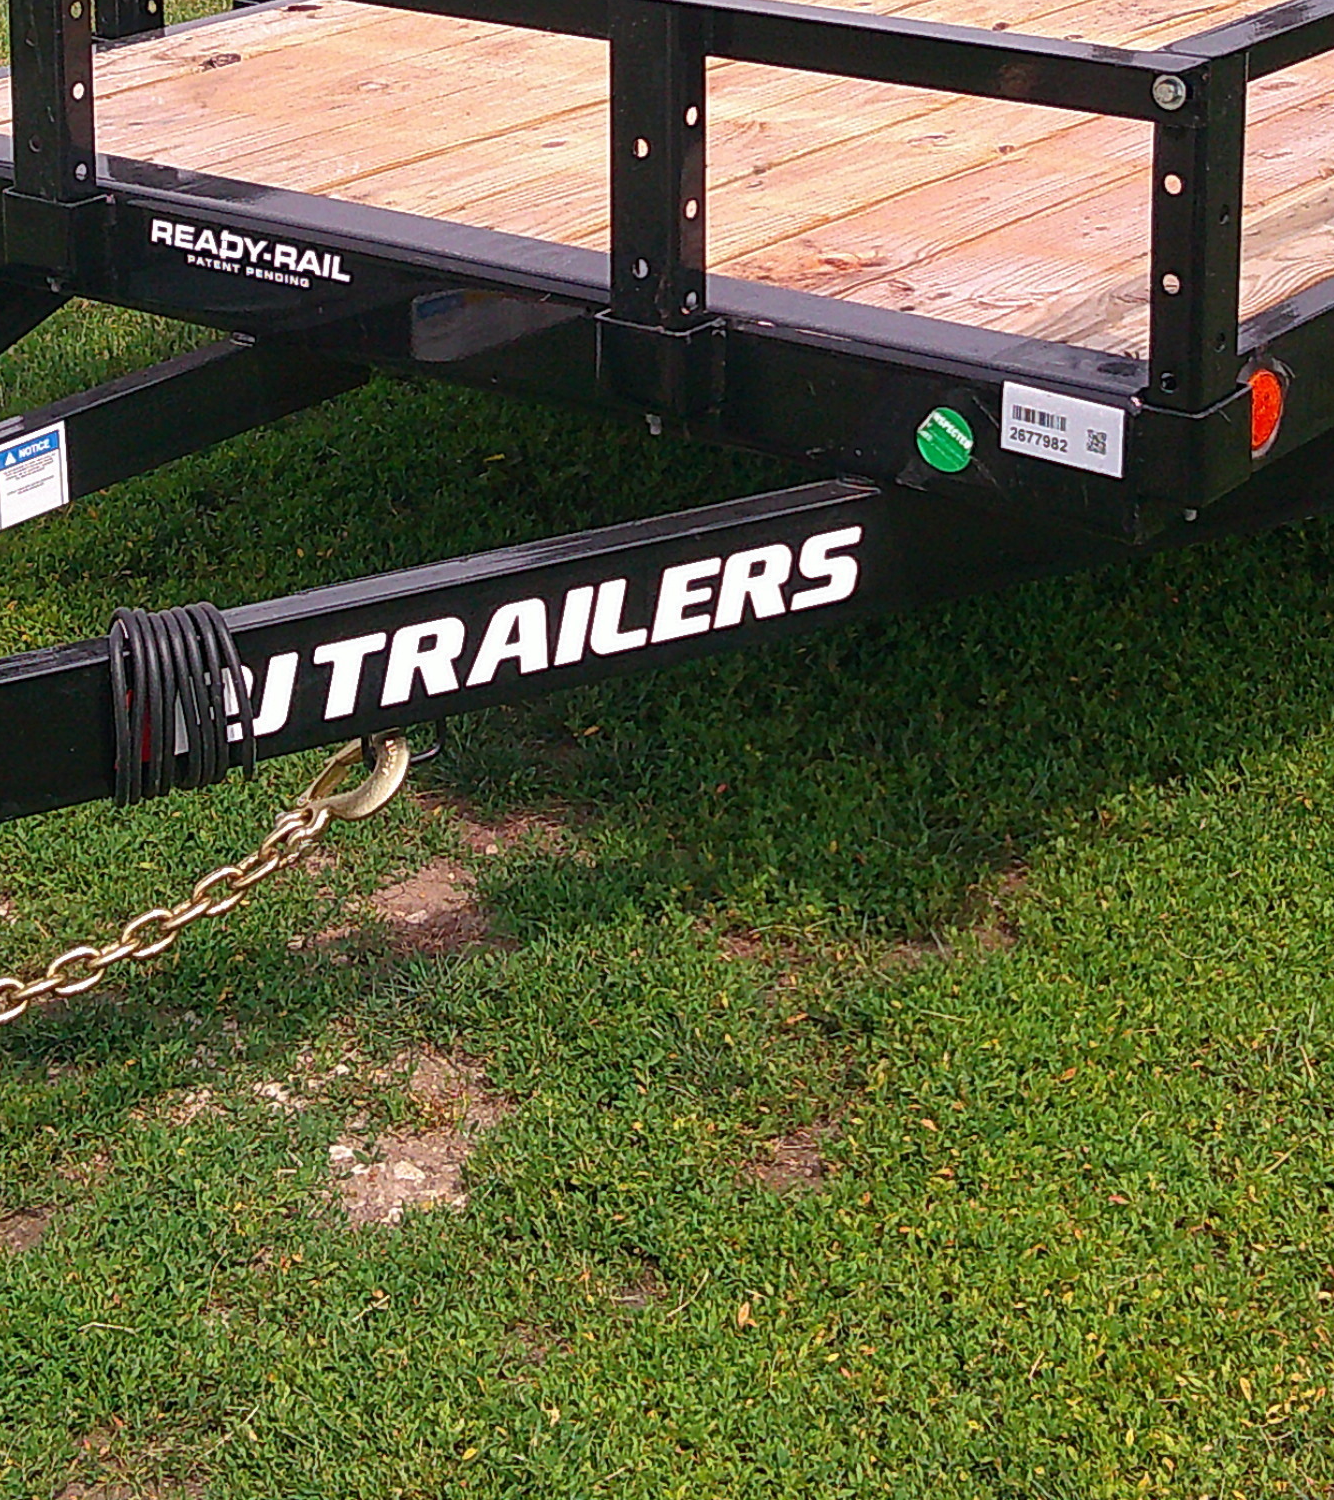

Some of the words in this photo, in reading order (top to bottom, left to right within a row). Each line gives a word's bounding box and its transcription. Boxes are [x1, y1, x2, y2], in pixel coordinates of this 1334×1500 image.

[150, 217, 352, 284] READY-RAIL
[186, 253, 241, 276] PATENT
[245, 264, 312, 289] PENDING
[18, 438, 51, 459] NOTICE
[1009, 426, 1069, 453] 2677982
[311, 525, 865, 721] TRAILERS
